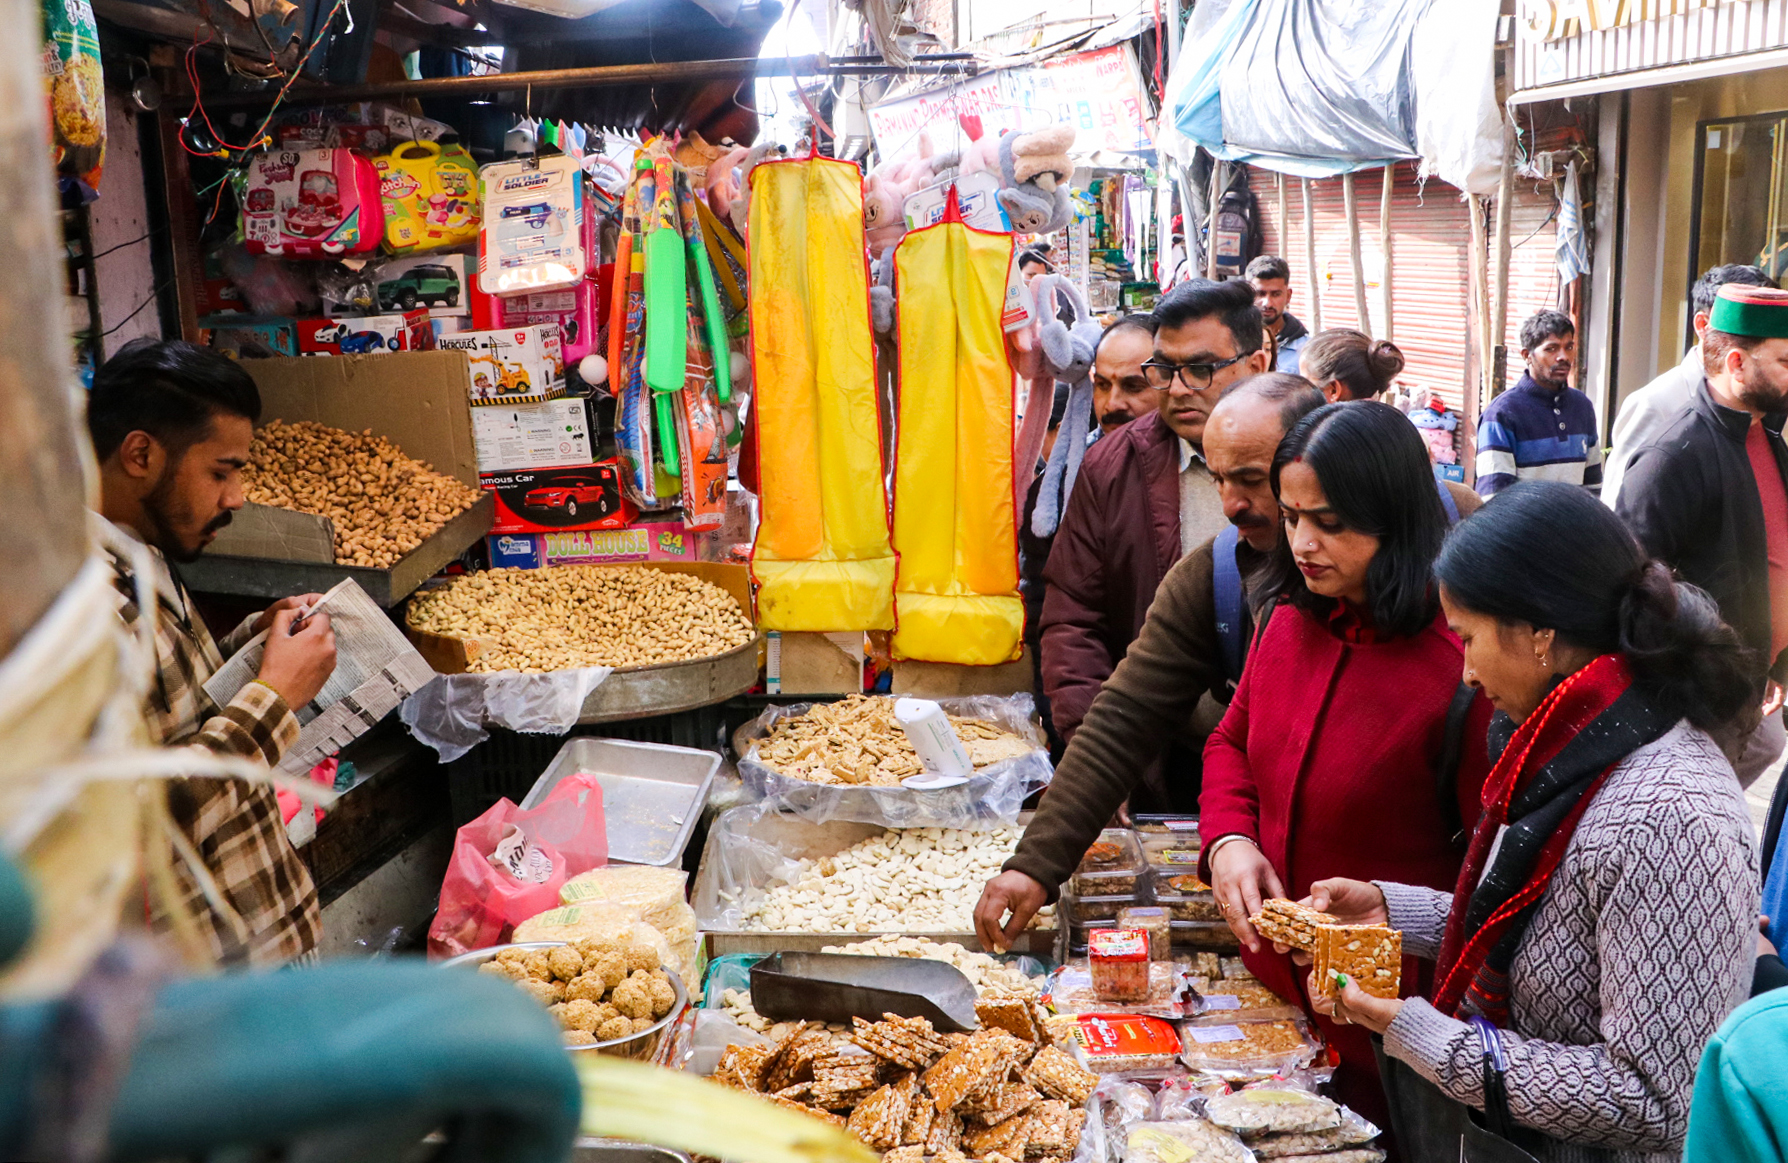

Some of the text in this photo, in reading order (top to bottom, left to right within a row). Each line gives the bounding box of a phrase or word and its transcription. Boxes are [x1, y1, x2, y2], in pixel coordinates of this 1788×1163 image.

[503, 178, 549, 190] SOLDIER
[505, 173, 542, 185] LITTLE
[439, 337, 478, 351] HERCULES
[1447, 469, 1460, 477] AIR
[480, 474, 535, 485] amous Car
[546, 529, 649, 557] DOLL HOUSE
[661, 531, 683, 548] 34
[660, 544, 683, 556] PIECES
